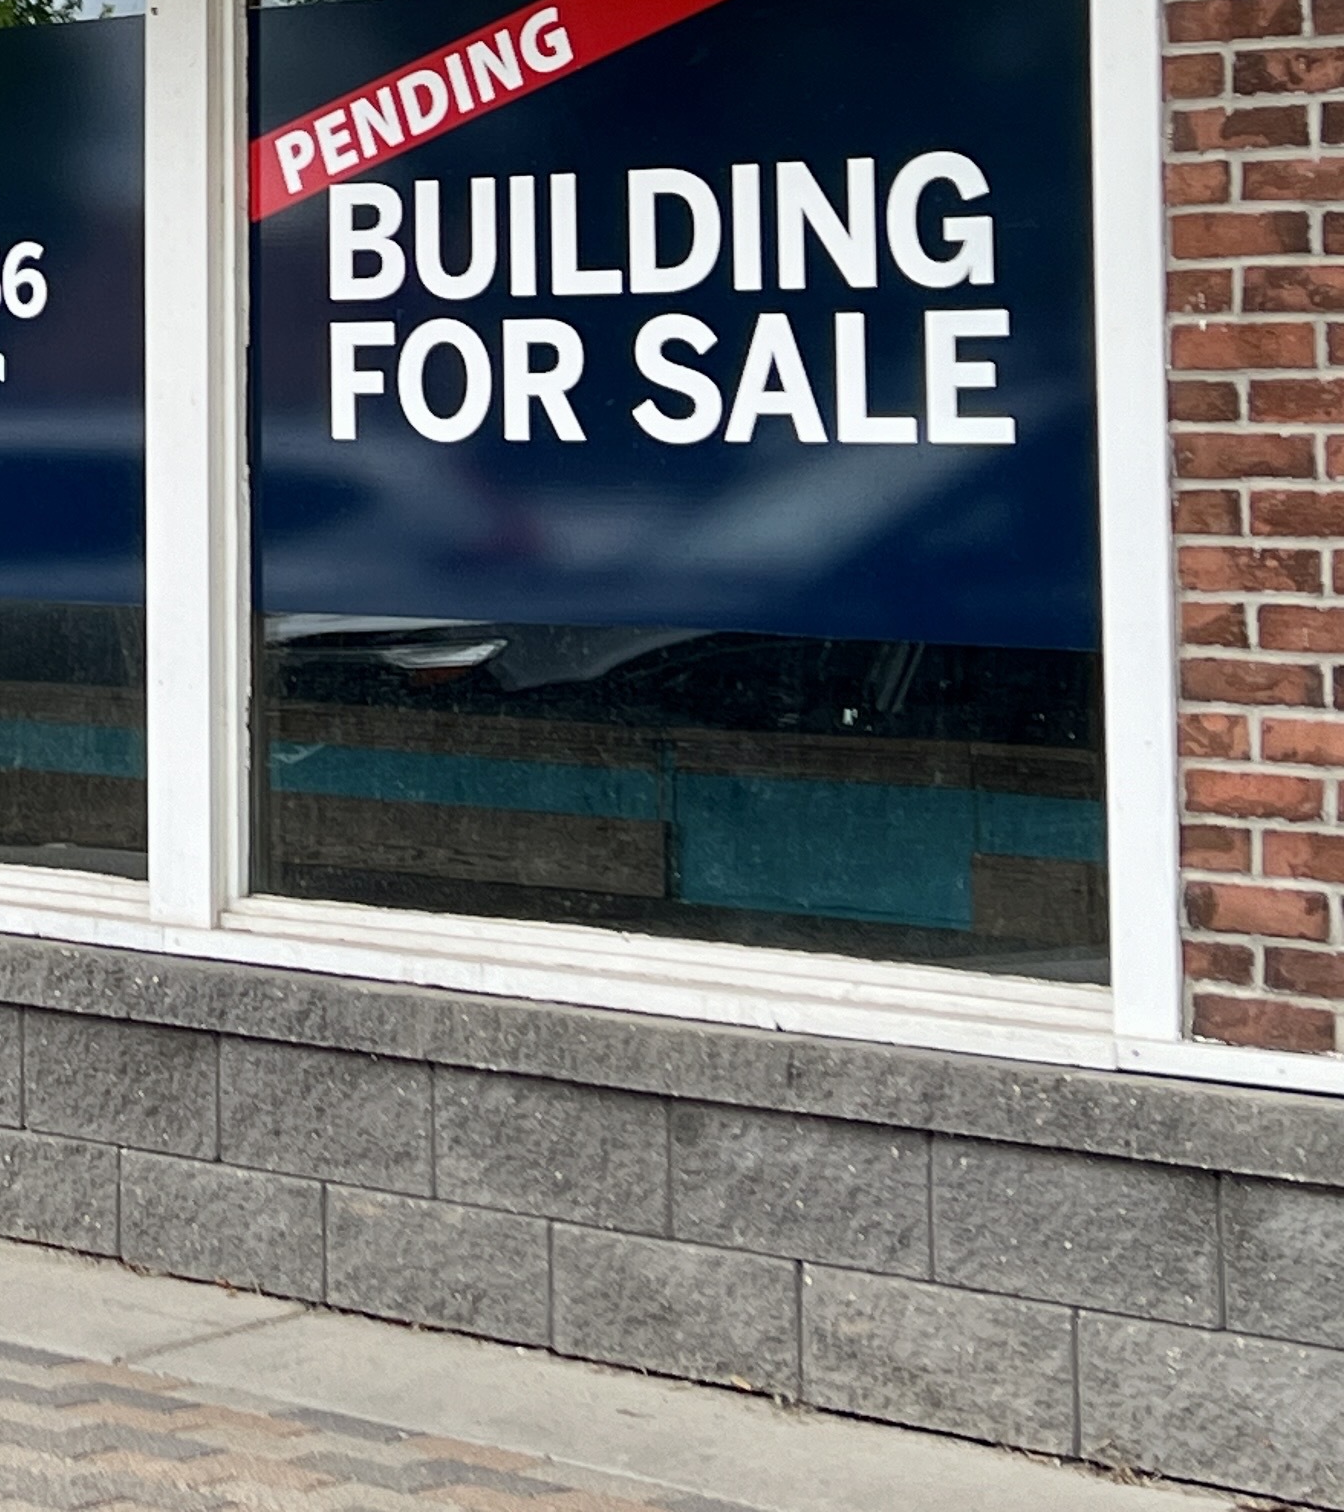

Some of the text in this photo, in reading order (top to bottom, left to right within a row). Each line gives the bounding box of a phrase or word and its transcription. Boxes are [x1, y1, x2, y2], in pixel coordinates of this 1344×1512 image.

[273, 5, 575, 194] PENDING
[328, 150, 995, 301] BUILDING
[329, 307, 1016, 445] FOR SALE
